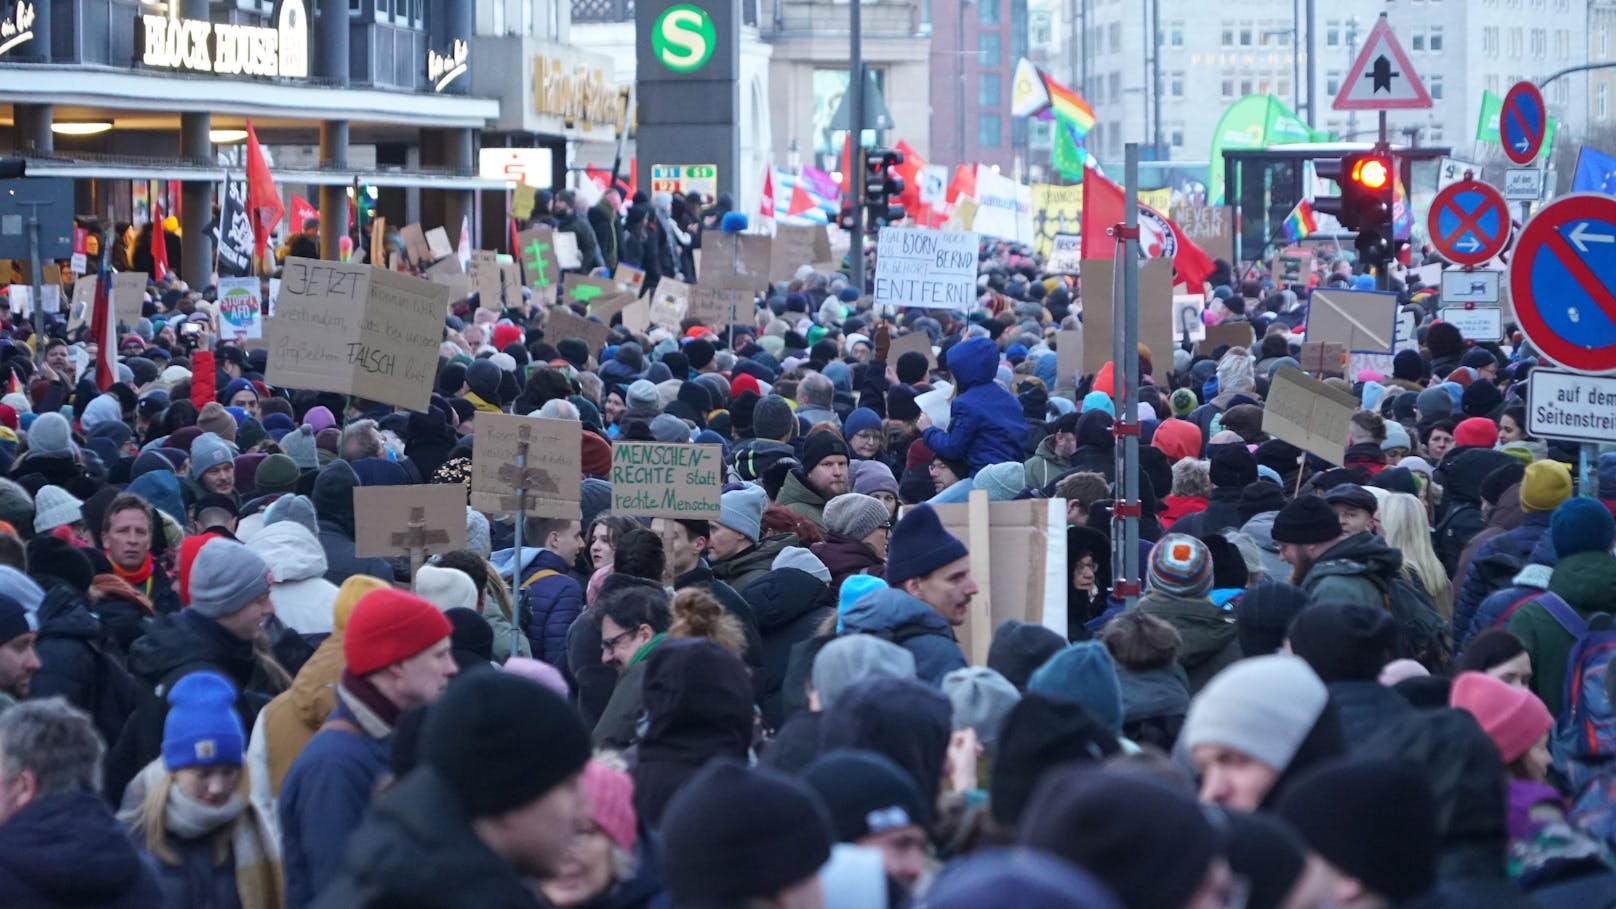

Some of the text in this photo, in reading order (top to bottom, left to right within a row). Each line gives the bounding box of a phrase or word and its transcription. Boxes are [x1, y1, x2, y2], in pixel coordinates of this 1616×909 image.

[143, 14, 279, 77] BLOCK HOUSE
[662, 9, 706, 67] S
[1176, 207, 1223, 222] NEVER
[902, 231, 938, 255] BJÖRN
[936, 249, 973, 269] BERND
[287, 264, 366, 300] JETZT
[876, 278, 972, 304] ENTFERNT
[346, 342, 396, 377] FALSCH
[1557, 386, 1580, 403] auf
[1536, 405, 1616, 431] Seitenstrei
[614, 444, 712, 467] MENSCHEN-
[614, 466, 717, 487] RECHTE statt
[615, 487, 720, 512] rechte Menschen
